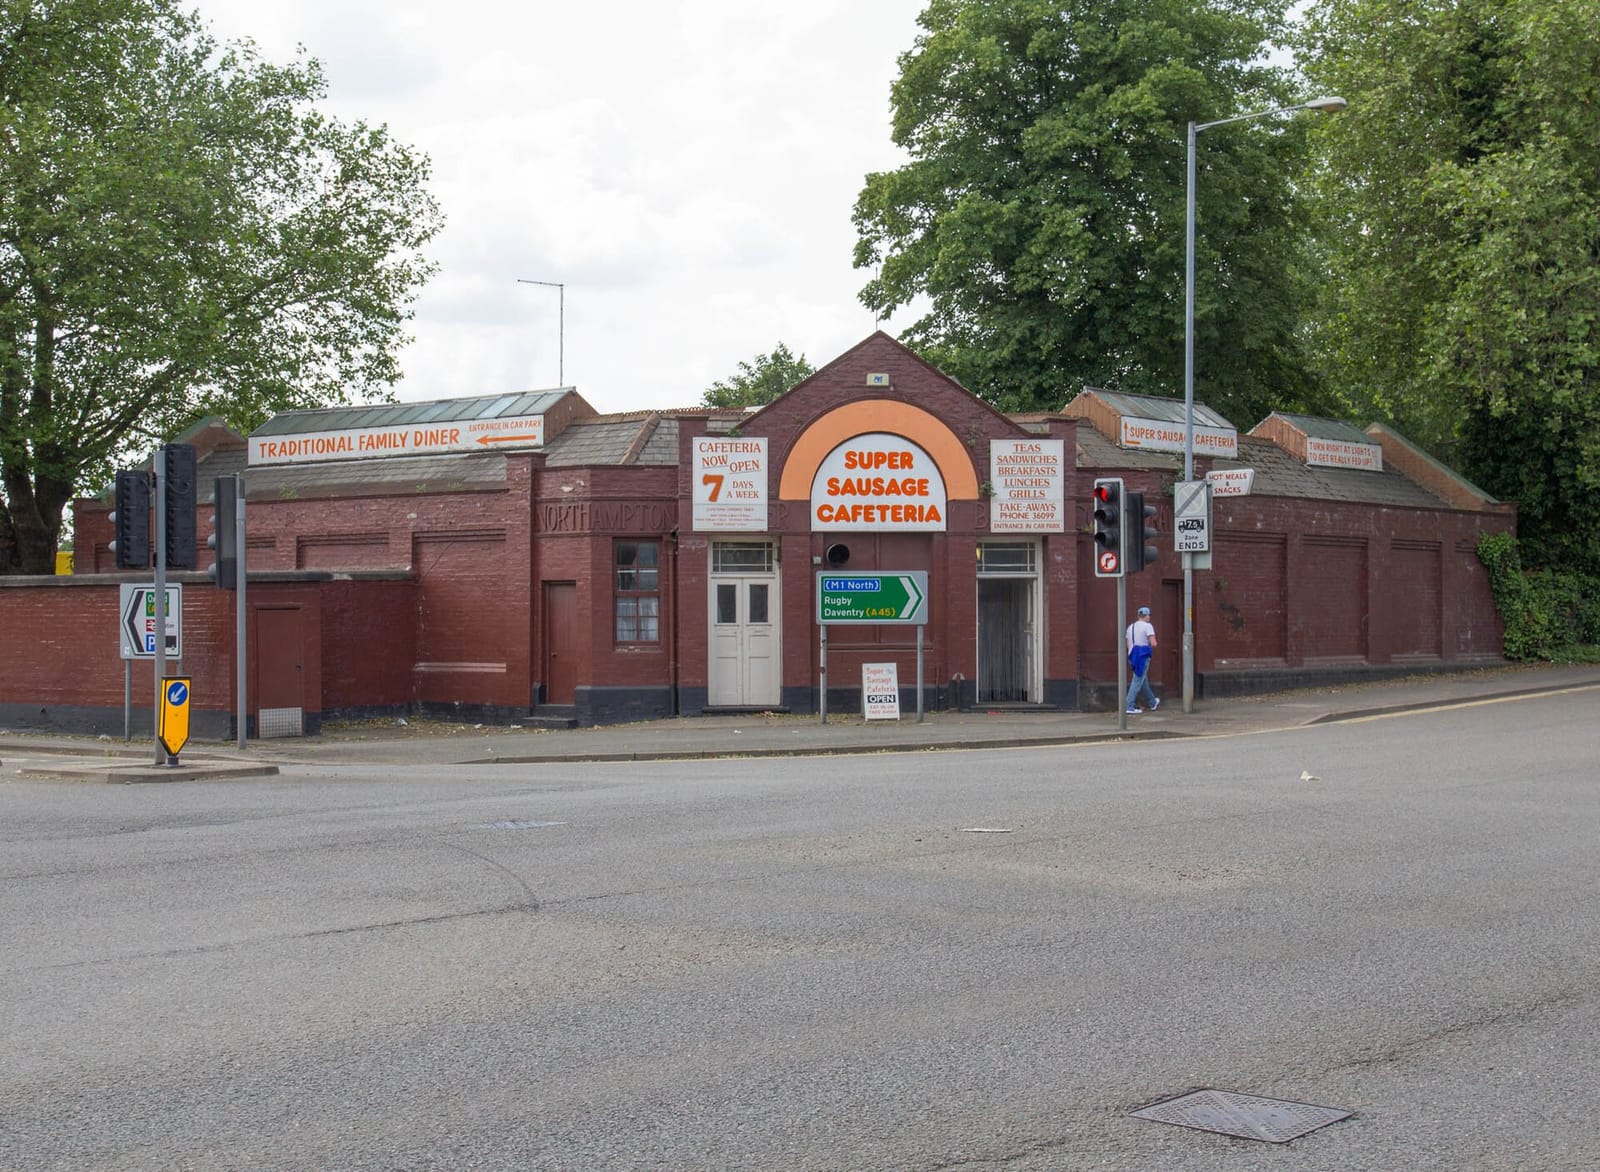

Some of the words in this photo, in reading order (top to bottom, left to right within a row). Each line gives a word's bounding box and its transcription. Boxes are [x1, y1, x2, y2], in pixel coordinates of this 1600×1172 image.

[469, 422, 501, 432] ENTRANCE
[502, 421, 509, 429] IN
[510, 420, 523, 429] CAR
[525, 419, 542, 428] PARK
[1130, 426, 1155, 440] SUPER
[1157, 430, 1187, 443] SAUSA
[1195, 433, 1235, 449] CAFETERIA
[259, 436, 354, 458] TRADITIONAL
[359, 431, 408, 451] FAMILY
[414, 428, 460, 447] DINER
[699, 442, 762, 453] CAFETERIA
[1013, 443, 1041, 452] TEAS
[702, 454, 728, 467] NOW
[729, 459, 760, 473] OPEN
[844, 450, 914, 470] SUPER
[997, 455, 1058, 464] SANDWICHES
[998, 466, 1057, 475] BREAKFASTS
[1225, 472, 1248, 480] MEALS
[827, 477, 929, 496] SAUSAGE
[1004, 478, 1050, 487] LUNCHES
[702, 473, 724, 503] 7
[732, 480, 754, 489] DAYS
[1214, 487, 1241, 495] SNACKS
[727, 490, 733, 498] A
[735, 490, 759, 498] WEEK
[1009, 489, 1046, 498] GRILLS
[535, 502, 677, 532] NORTHAMPTON
[817, 503, 942, 523] CAFETERIA
[1178, 541, 1205, 550] ENDS
[825, 580, 844, 590] (M1
[847, 580, 879, 590] North)
[824, 596, 852, 606] Rugby
[824, 608, 864, 618] Daventry
[865, 607, 897, 617] (A45)
[869, 695, 894, 703] OPEN
